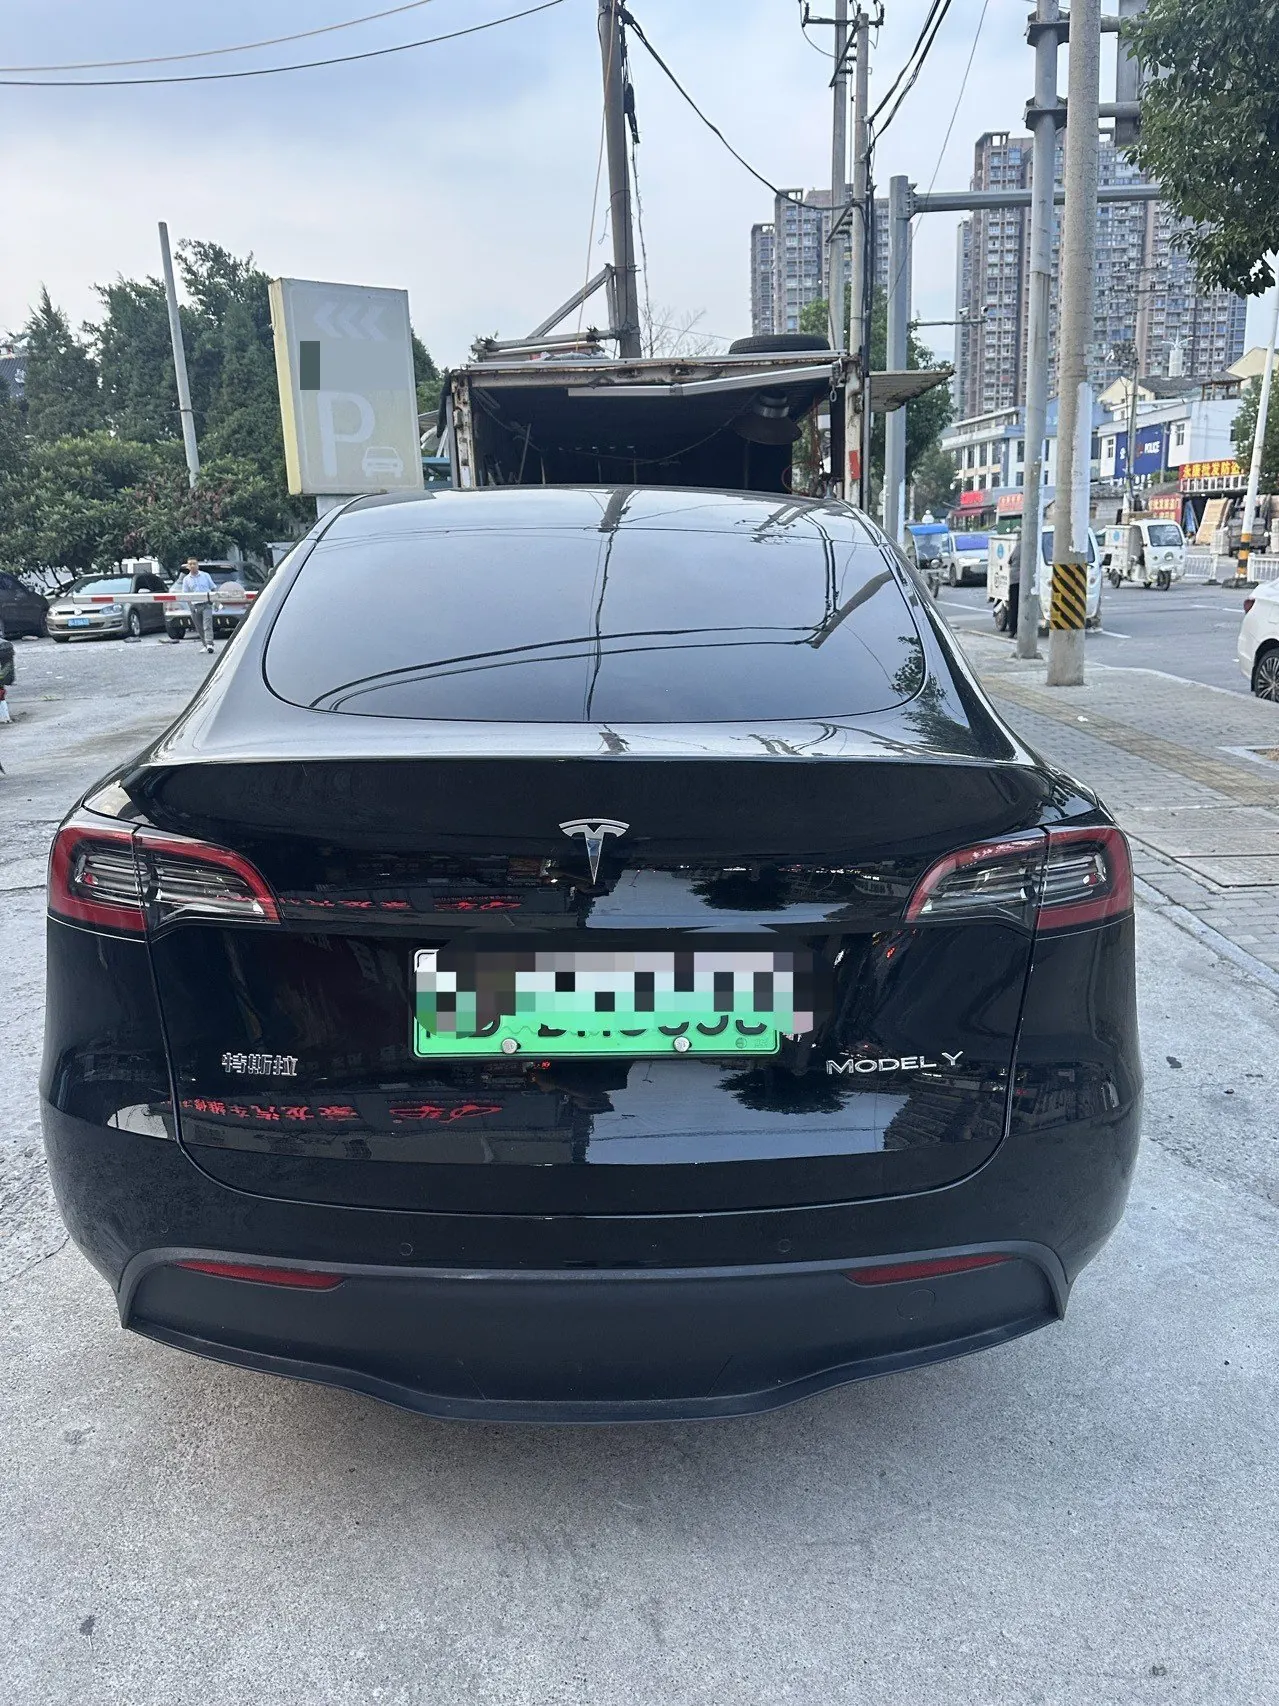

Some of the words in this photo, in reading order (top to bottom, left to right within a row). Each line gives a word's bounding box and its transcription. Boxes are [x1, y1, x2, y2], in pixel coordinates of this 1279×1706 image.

[317, 391, 376, 477] P
[221, 1052, 298, 1076] 特斯拉
[826, 1056, 937, 1075] MODEL
[941, 1050, 964, 1066] Y
